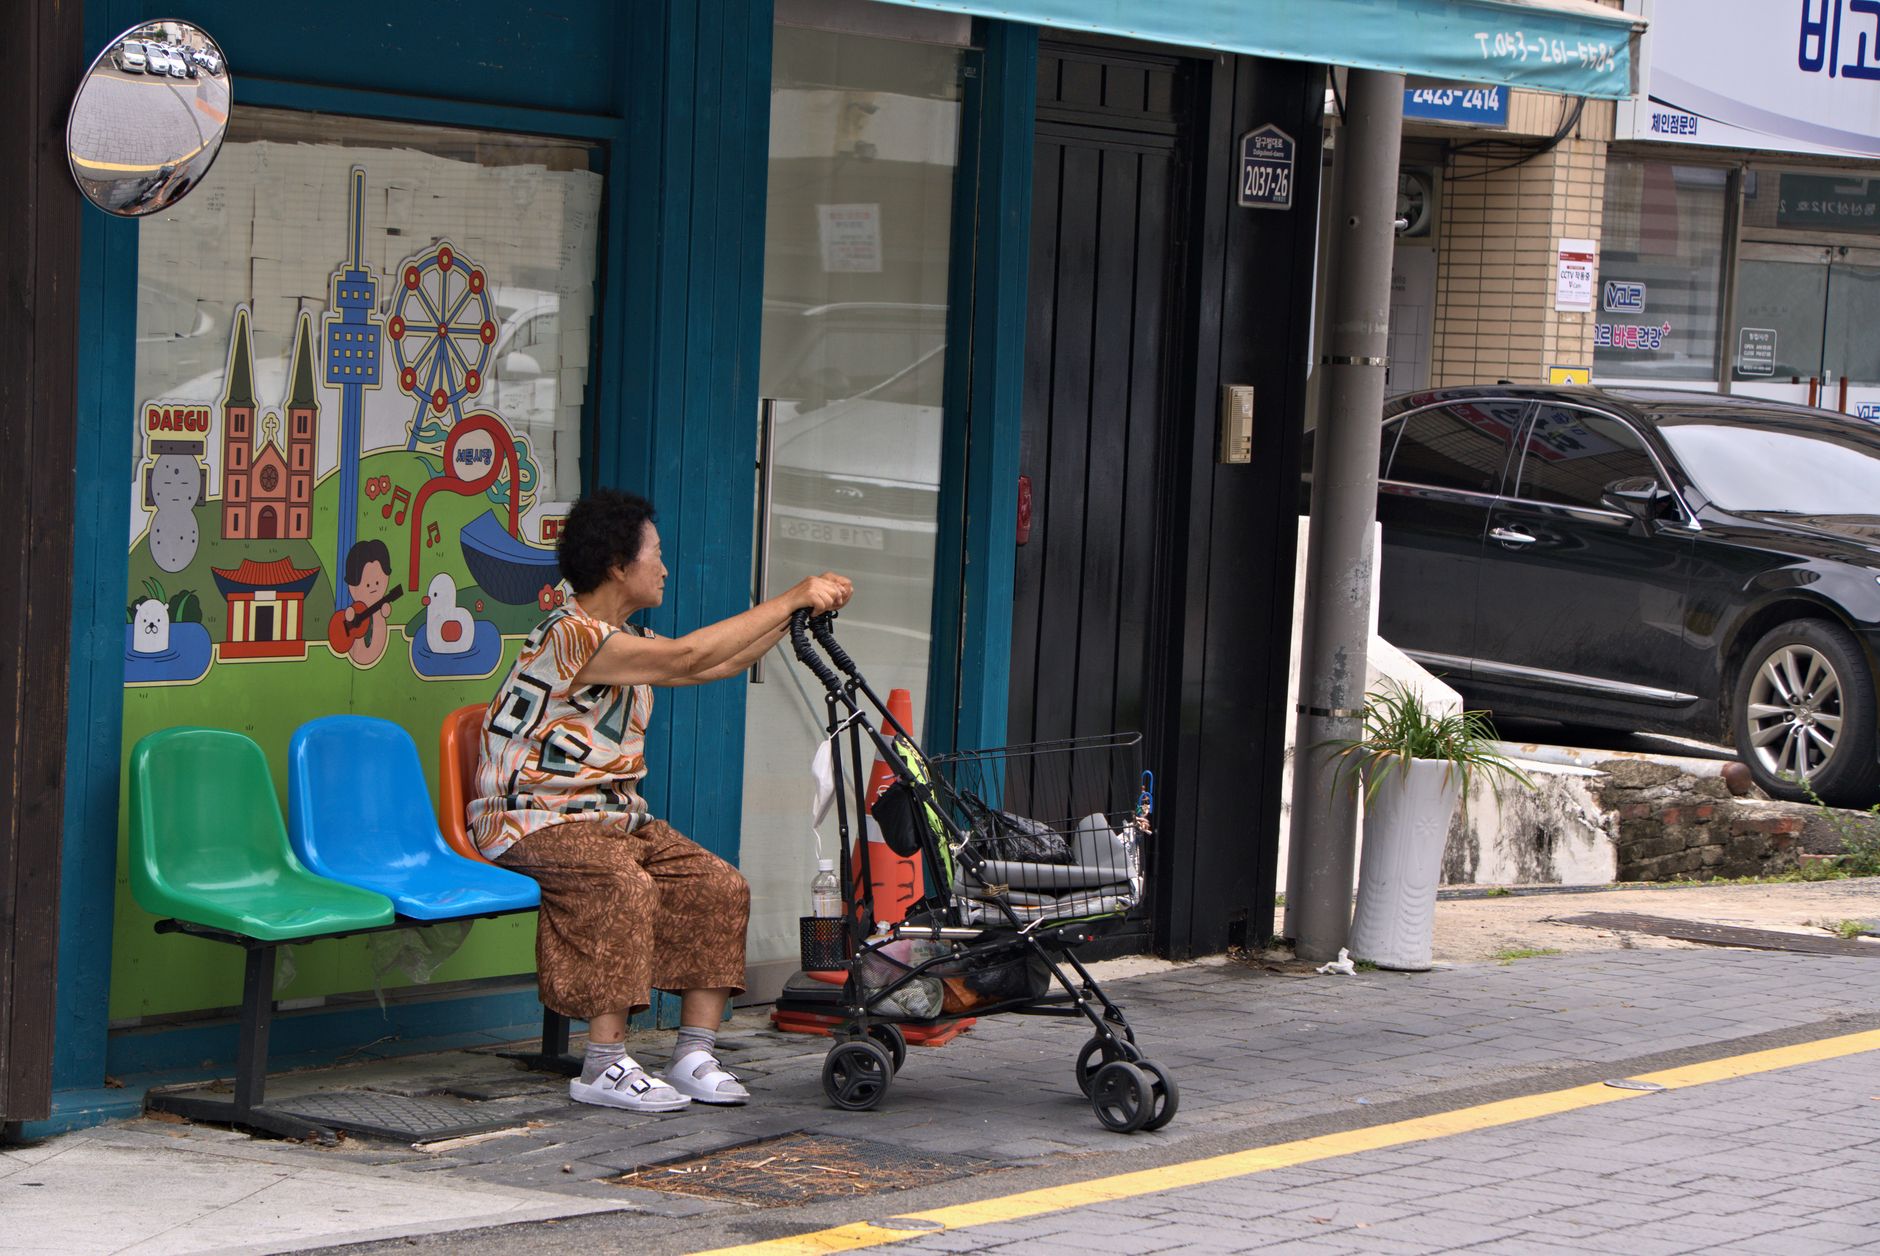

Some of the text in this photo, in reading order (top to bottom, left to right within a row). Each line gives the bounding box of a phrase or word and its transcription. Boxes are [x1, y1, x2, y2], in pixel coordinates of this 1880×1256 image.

[1651, 113, 1698, 136] 체인점문의
[1245, 165, 1288, 197] 2037-26
[1561, 270, 1574, 279] CCTV
[148, 409, 209, 432] DAEGU
[456, 448, 492, 465] 서문시장
